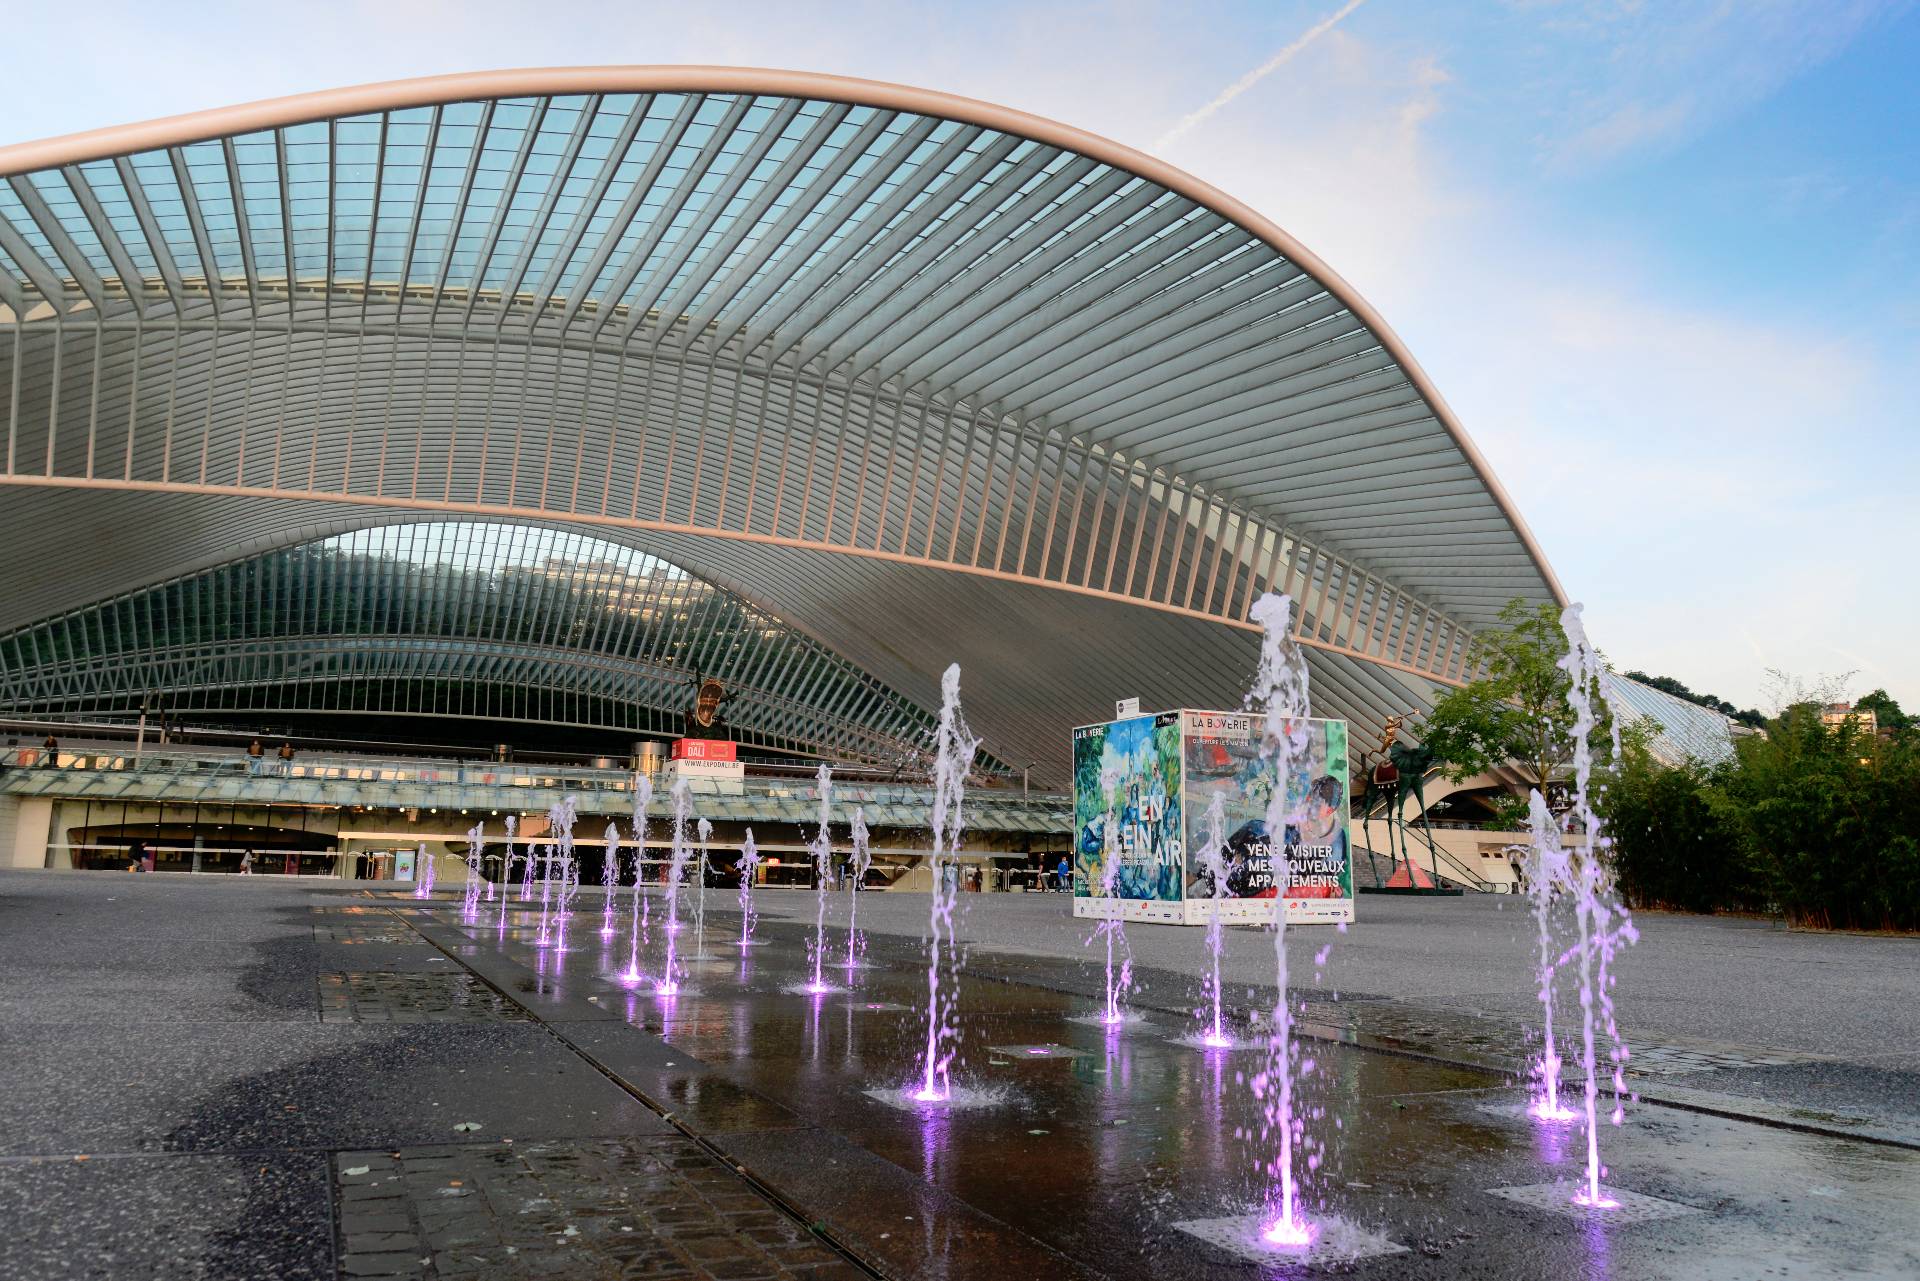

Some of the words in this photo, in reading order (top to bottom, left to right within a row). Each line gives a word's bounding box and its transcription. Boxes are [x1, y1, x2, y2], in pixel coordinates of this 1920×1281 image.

[1192, 717, 1204, 728] LA
[1207, 718, 1248, 731] BOVERIE
[1075, 731, 1082, 740] LA
[688, 746, 704, 757] DALI
[1139, 795, 1164, 821] EN
[1154, 838, 1182, 866] AIR
[1291, 845, 1333, 858] VISITER
[1248, 859, 1274, 872] MES
[1284, 860, 1345, 873] OUVEAUX
